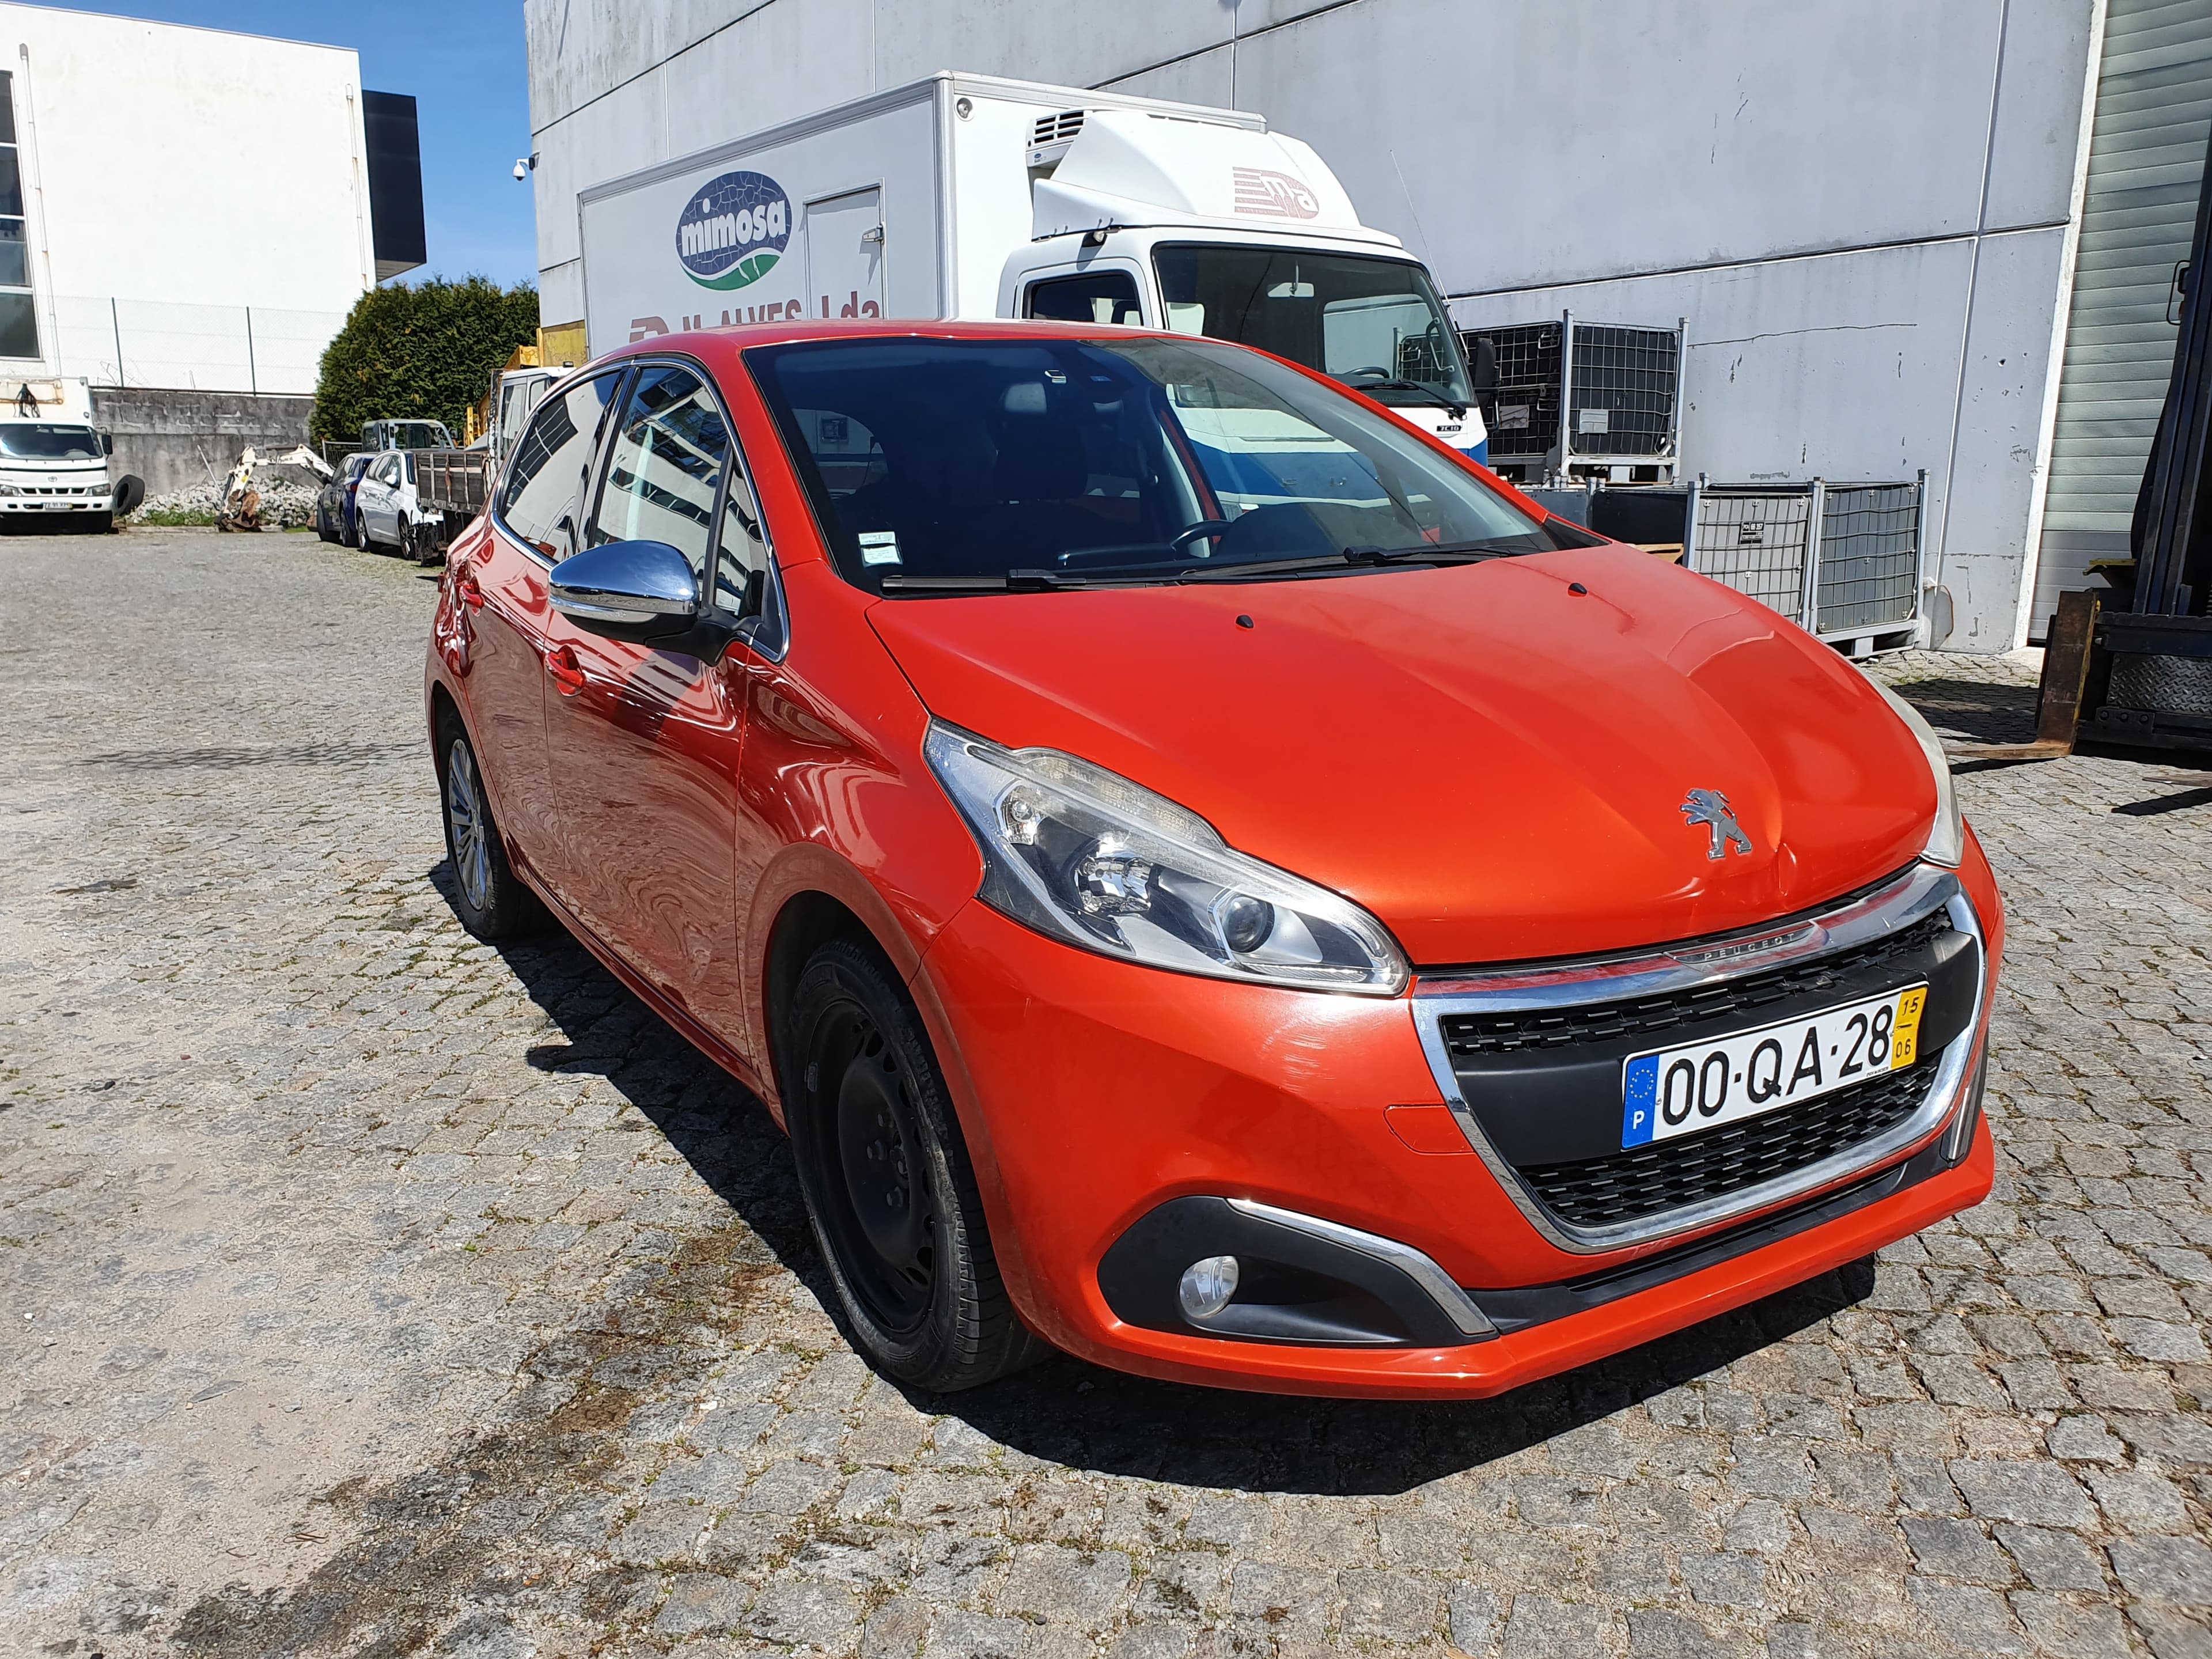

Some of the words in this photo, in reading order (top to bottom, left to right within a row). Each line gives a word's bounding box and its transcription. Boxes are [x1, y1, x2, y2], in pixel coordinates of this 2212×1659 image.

[681, 198, 787, 257] mimosa
[1704, 933, 1795, 961] PEUGEOT
[1902, 996, 1920, 1016] 15
[1896, 1038, 1911, 1058] 06
[1633, 1110, 1645, 1130] P
